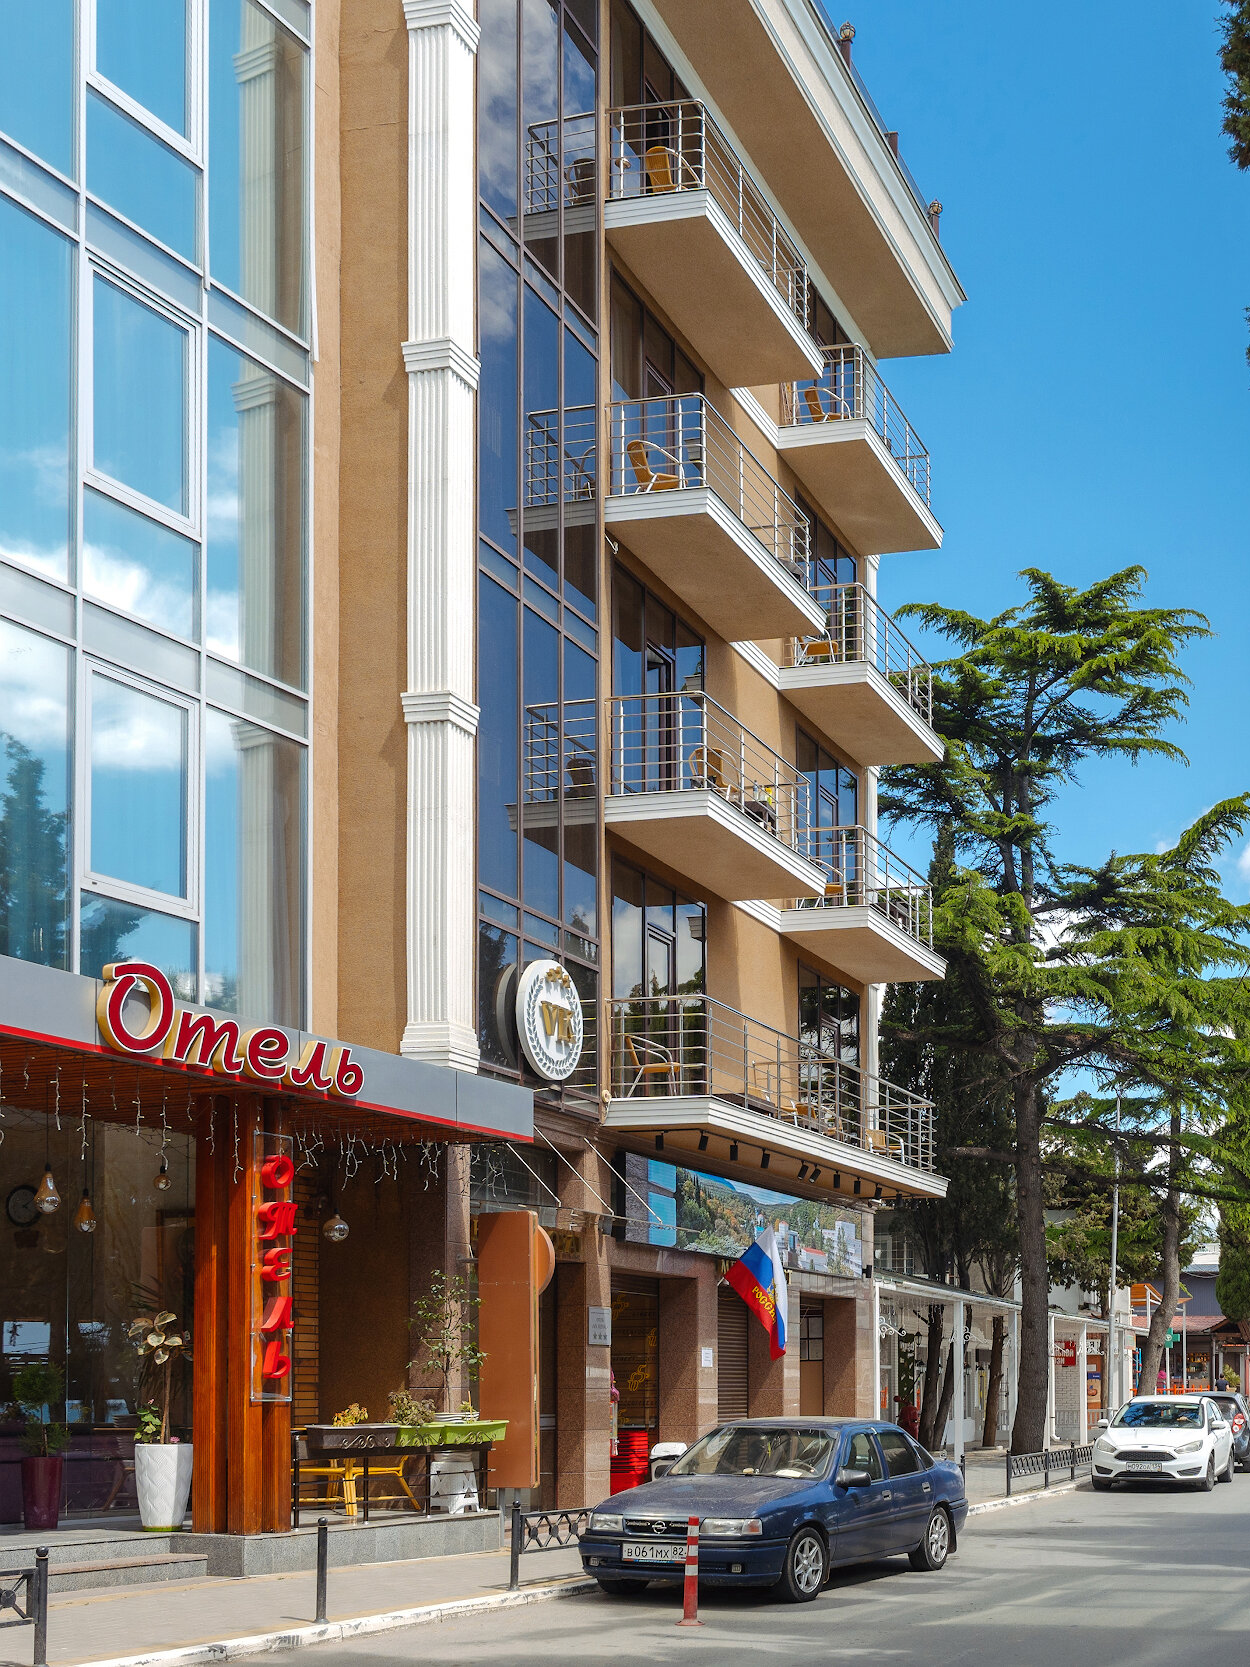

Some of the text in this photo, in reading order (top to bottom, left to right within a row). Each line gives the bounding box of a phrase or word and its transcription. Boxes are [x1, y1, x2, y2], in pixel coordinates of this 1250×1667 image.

[98, 961, 365, 1096] Отель
[627, 1546, 670, 1559] В061МХ
[673, 1547, 684, 1556] 82
